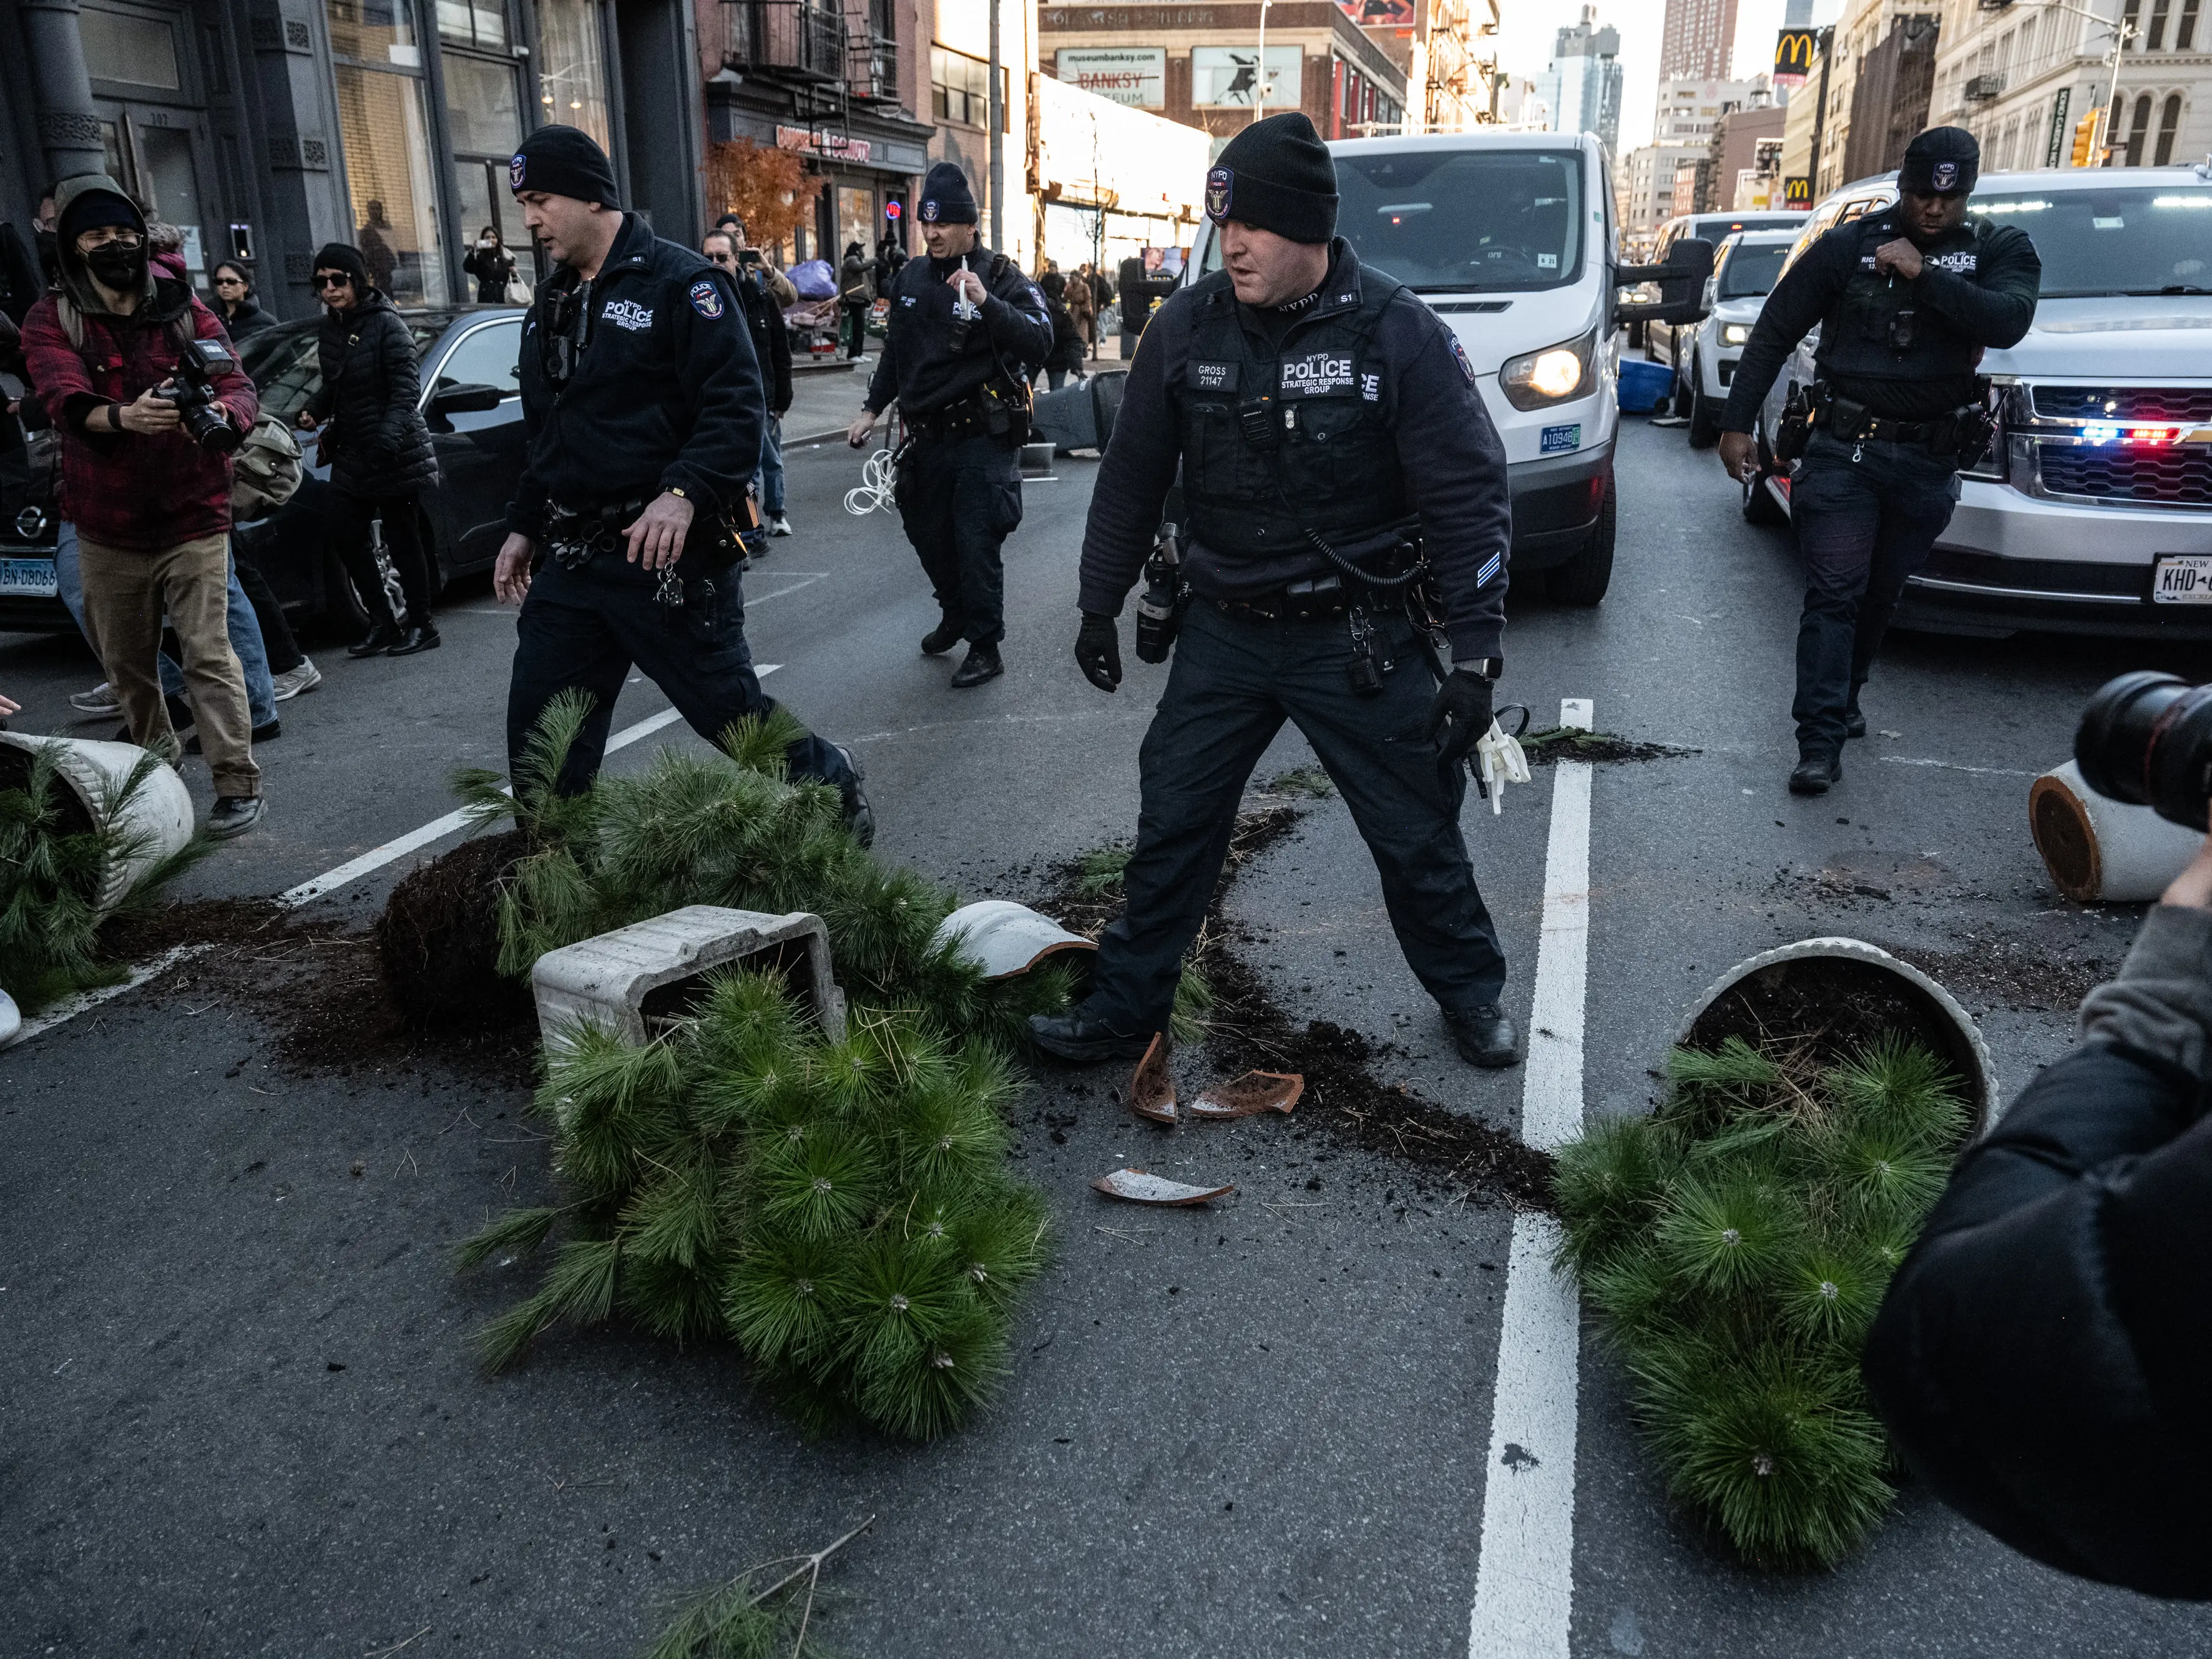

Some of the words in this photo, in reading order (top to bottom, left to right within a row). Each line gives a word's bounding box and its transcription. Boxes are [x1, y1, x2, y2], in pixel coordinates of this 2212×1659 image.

[1068, 52, 1156, 63] museumbanksy.com
[1079, 72, 1143, 89] BANKSY
[1103, 93, 1143, 104] EUM
[512, 156, 522, 164] PD
[1211, 170, 1227, 180] NYPD
[1941, 255, 1977, 266] POLICE
[690, 283, 712, 298] POLICE
[1278, 293, 1318, 312] NYPD
[1340, 294, 1352, 302] S1
[624, 300, 642, 311] NYPD
[605, 301, 653, 323] POLICE
[602, 312, 629, 323] STRATEGIC
[629, 319, 652, 328] RESPONSE
[617, 320, 637, 331] GROUP
[1306, 353, 1329, 362] NYPD
[1198, 365, 1226, 375] GROSS
[1283, 360, 1351, 380] POLICE
[1200, 376, 1222, 386] 21147
[1281, 379, 1318, 388] STRATEGIC
[1318, 377, 1354, 386] RESPONSE
[1304, 385, 1330, 394] GROUP
[2185, 560, 2210, 568] NEW
